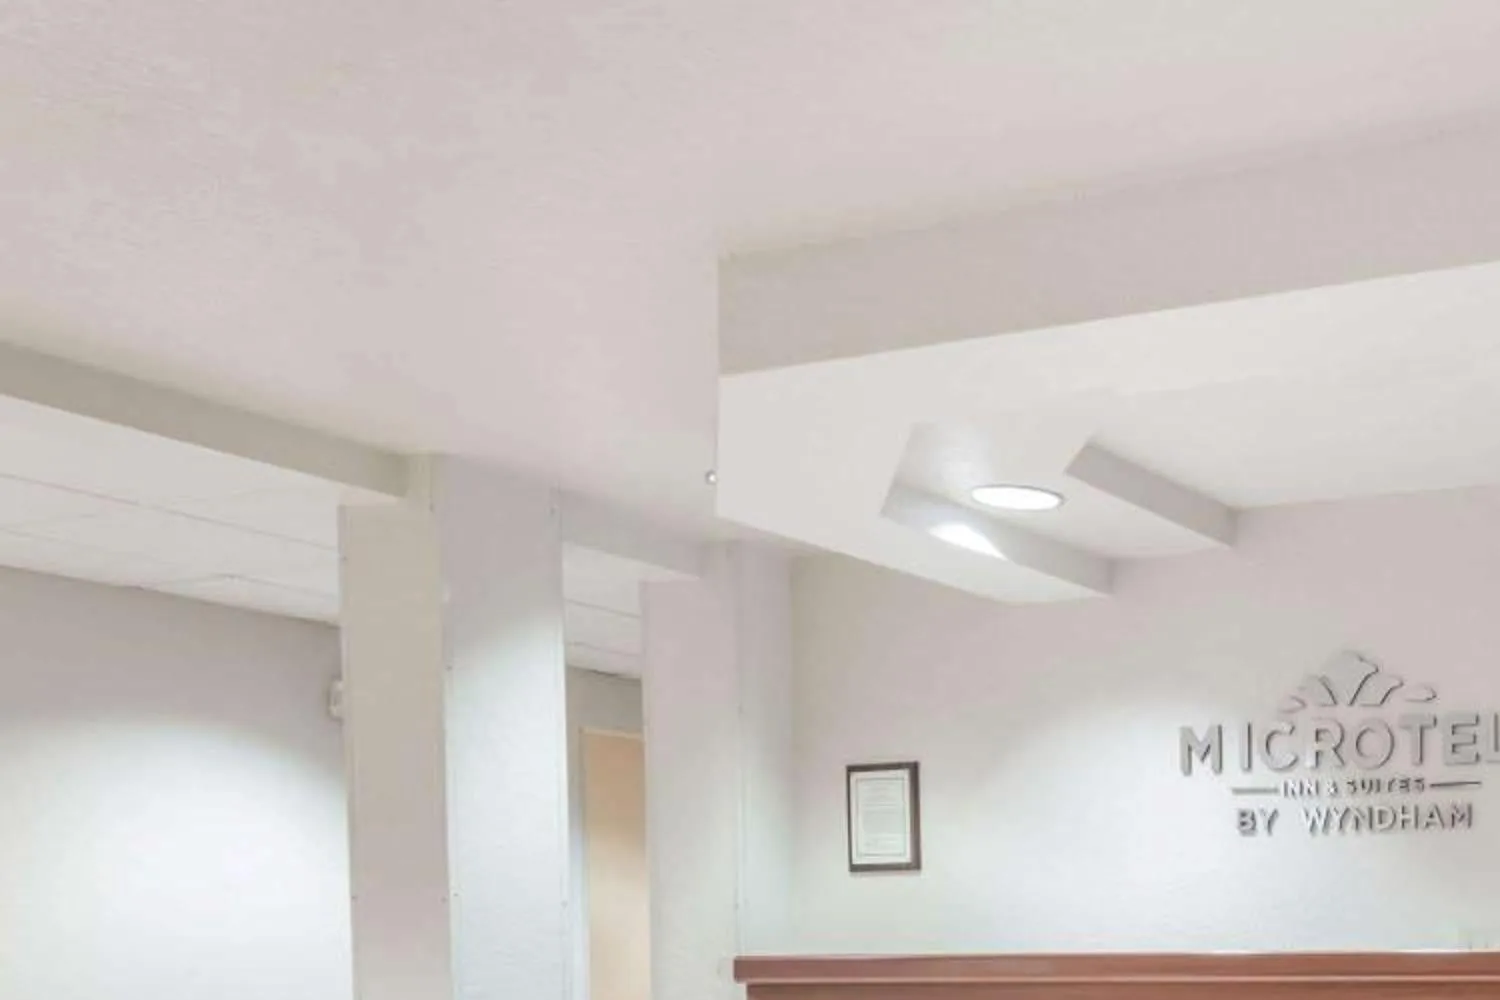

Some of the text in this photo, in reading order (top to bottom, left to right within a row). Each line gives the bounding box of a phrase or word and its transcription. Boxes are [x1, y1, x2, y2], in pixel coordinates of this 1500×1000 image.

[1283, 780, 1321, 799] INN
[1346, 776, 1426, 797] SUITES
[1237, 803, 1474, 838] BY WYNDHAM
